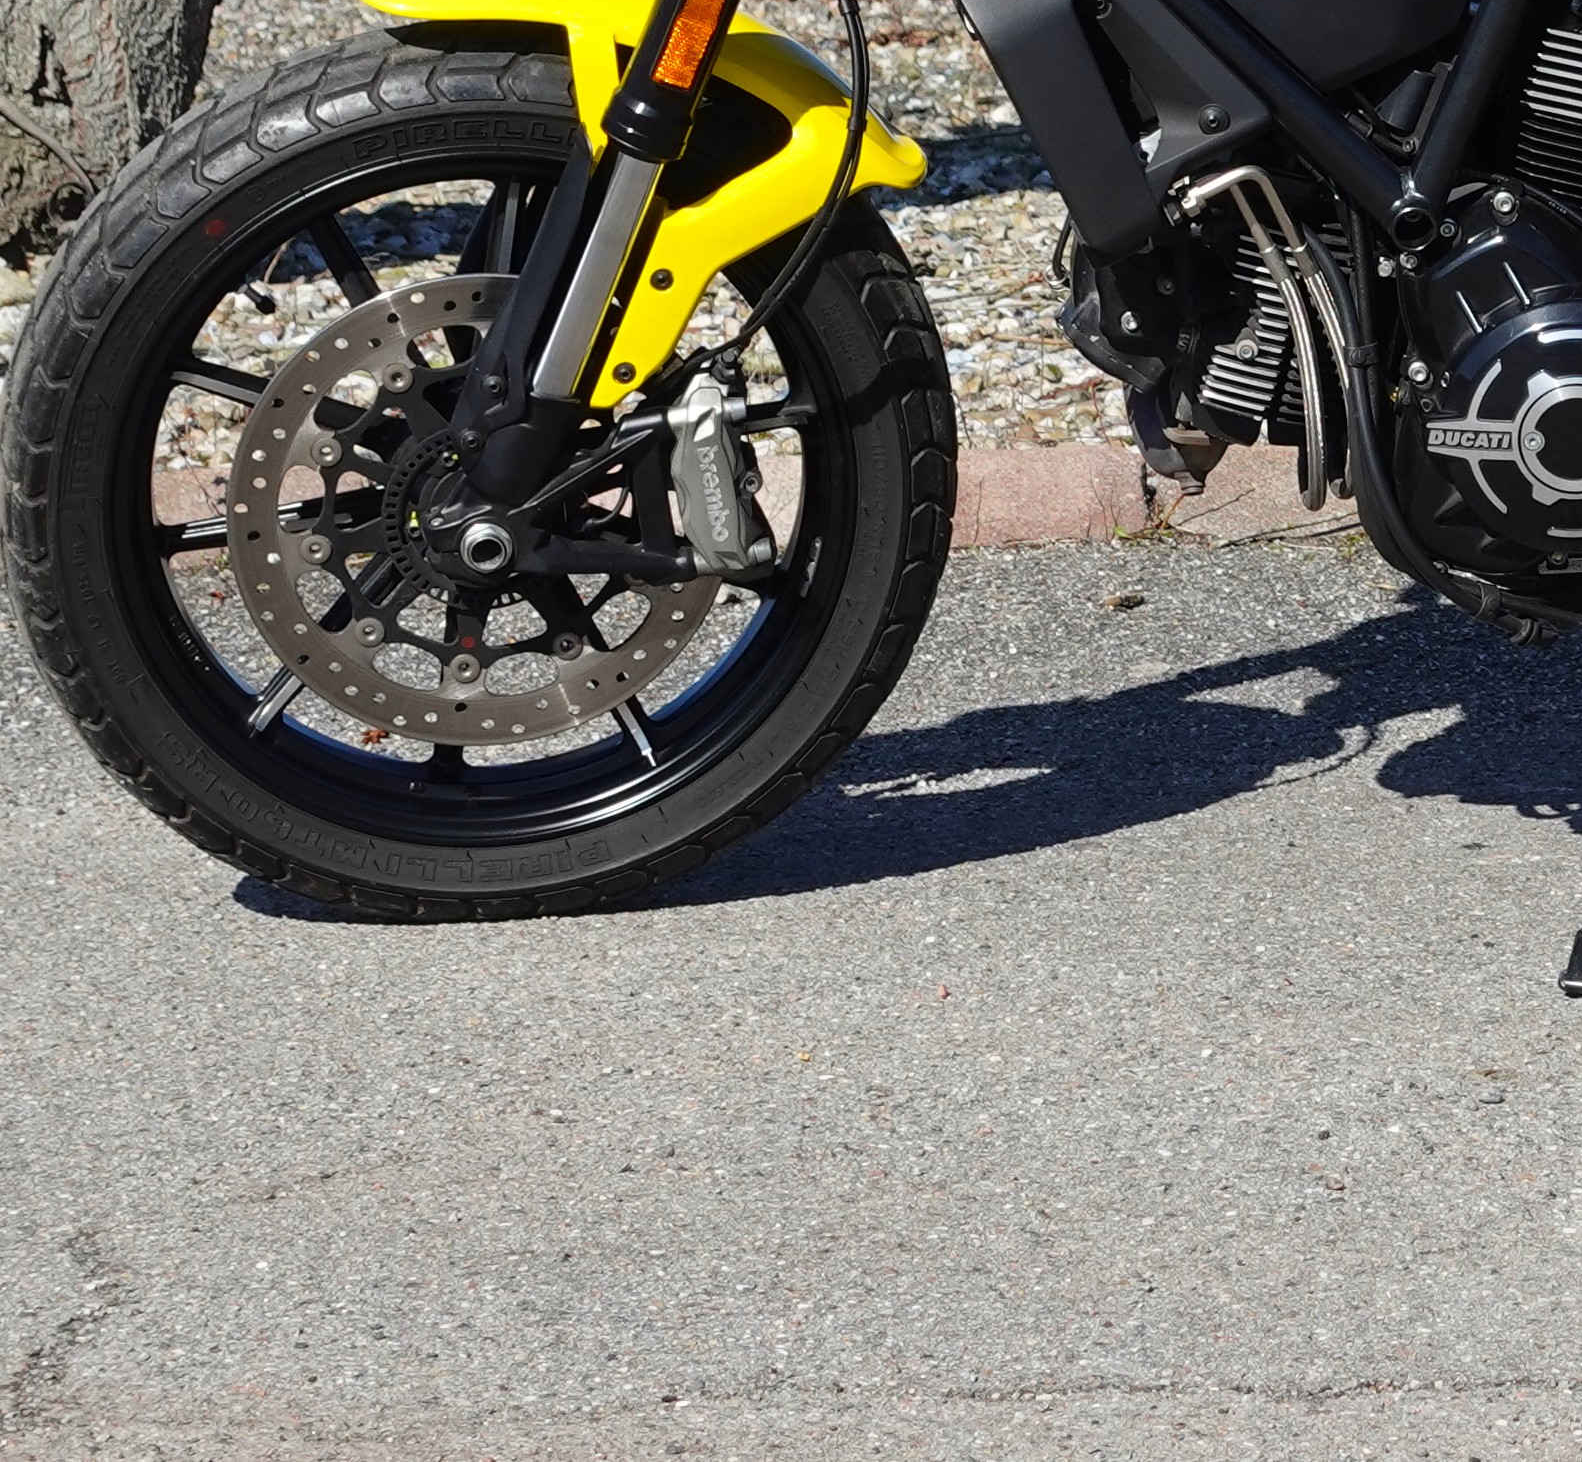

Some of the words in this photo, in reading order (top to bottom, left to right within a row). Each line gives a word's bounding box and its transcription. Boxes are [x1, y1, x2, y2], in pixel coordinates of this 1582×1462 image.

[1428, 430, 1510, 449] DUCATI
[697, 445, 729, 542] brembo
[383, 838, 613, 884] PIRELLI
